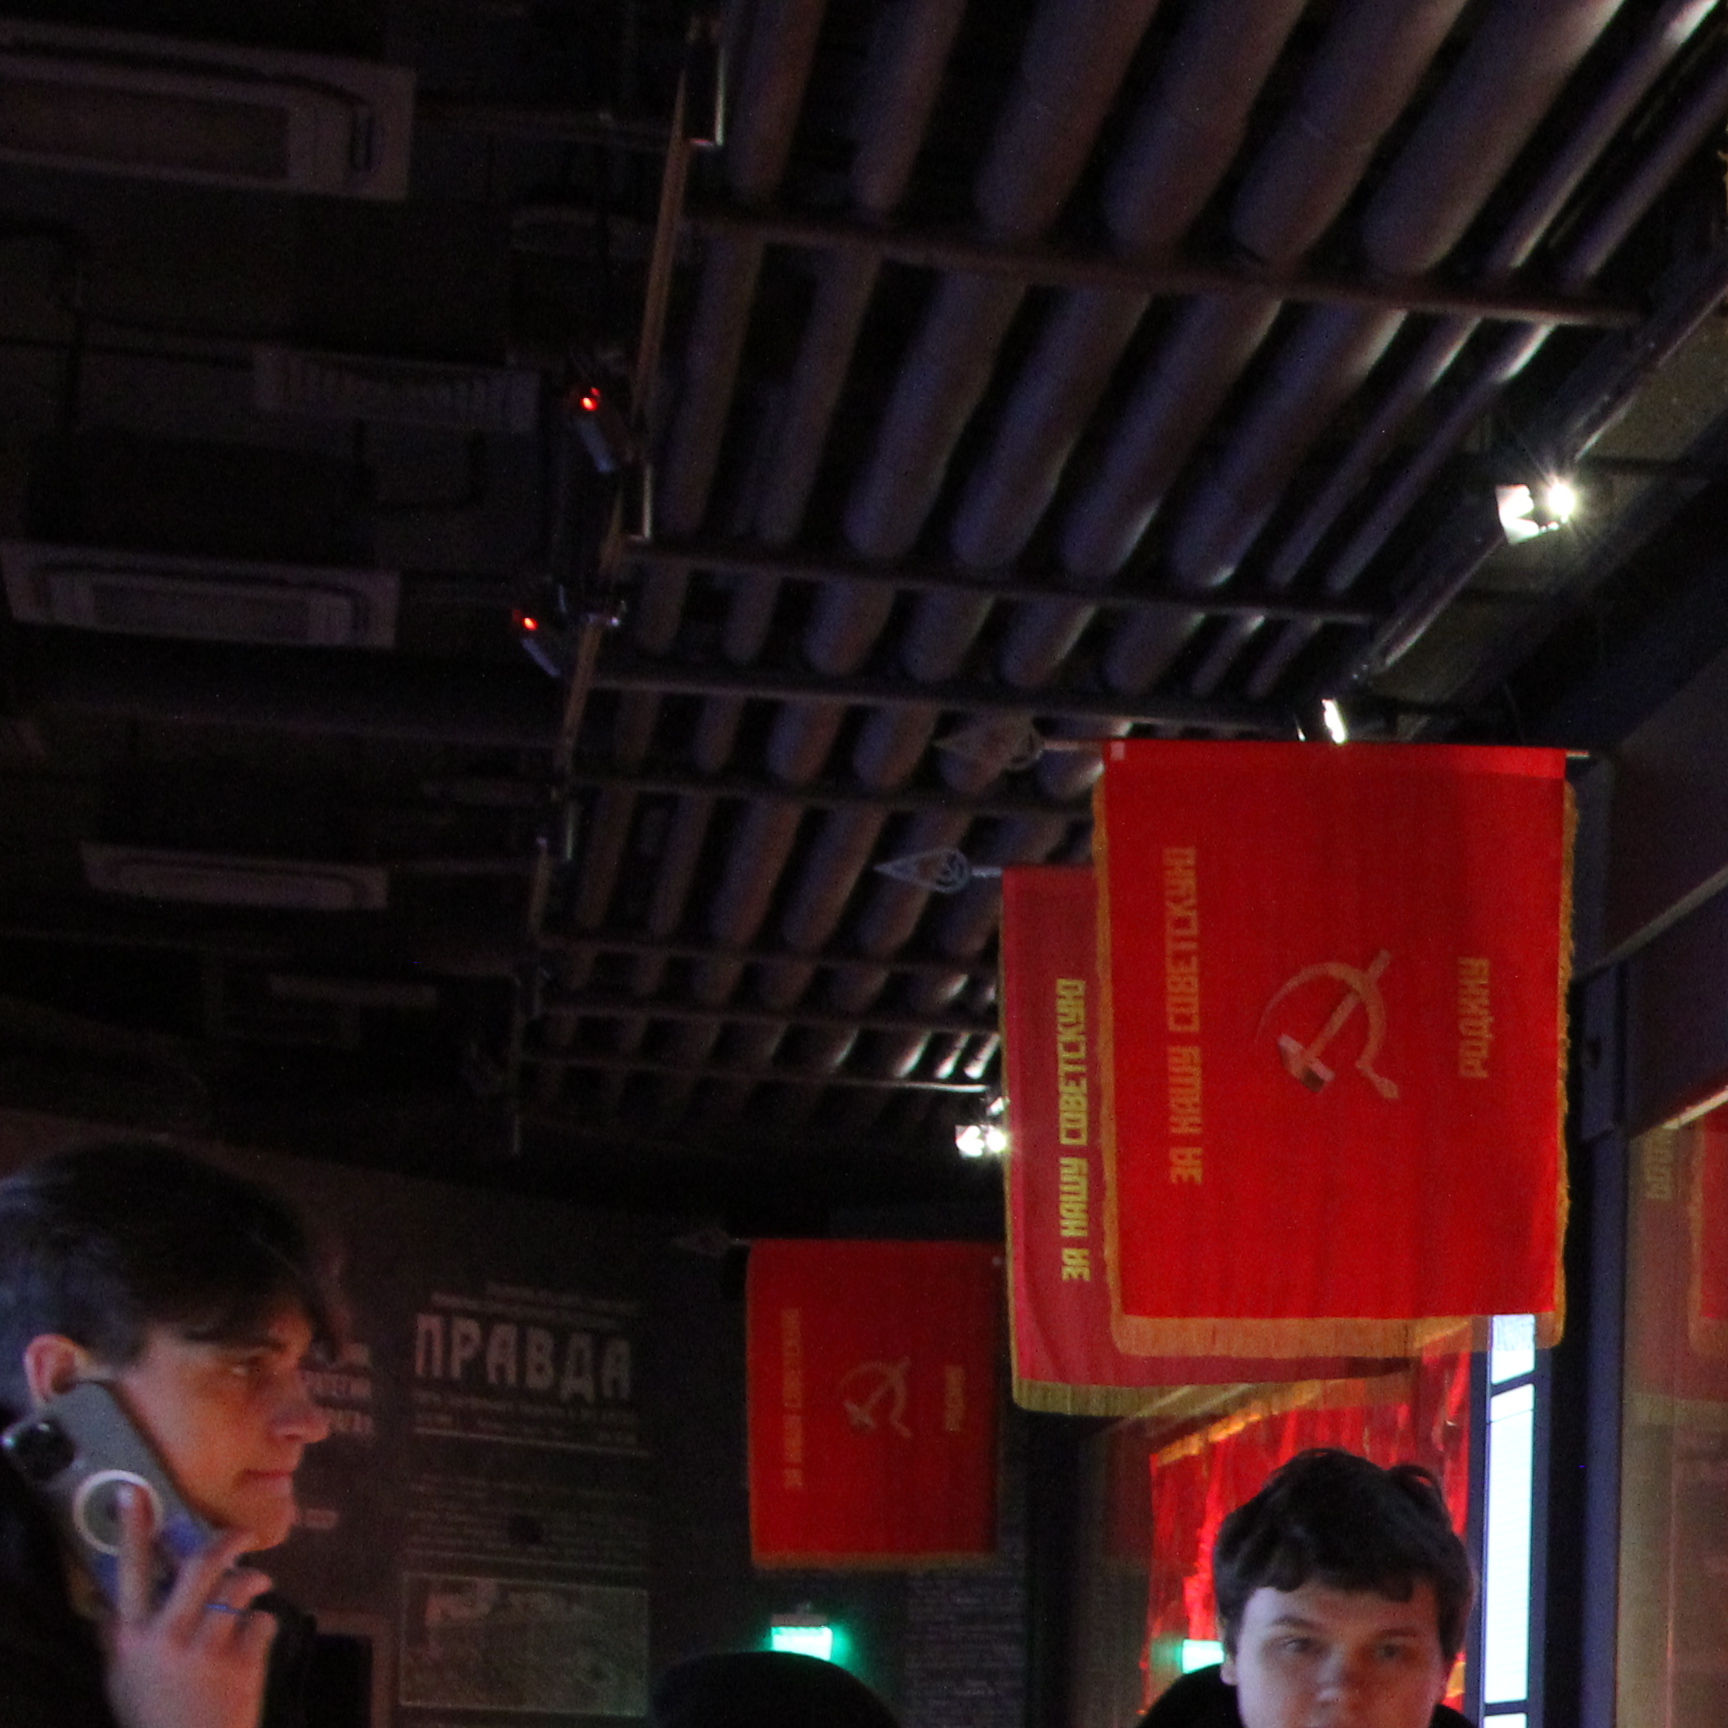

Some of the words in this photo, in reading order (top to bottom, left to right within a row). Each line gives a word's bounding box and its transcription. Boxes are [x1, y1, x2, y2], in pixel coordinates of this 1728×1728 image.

[1055, 978, 1089, 1146] СОВЕТСКУЮ
[1166, 1045, 1204, 1135] НАШУ
[1059, 1156, 1090, 1238] НАШУ
[1168, 1147, 1204, 1185] ЗА
[1061, 1247, 1091, 1282] ЗА
[413, 1311, 633, 1406] ПРАВДА
